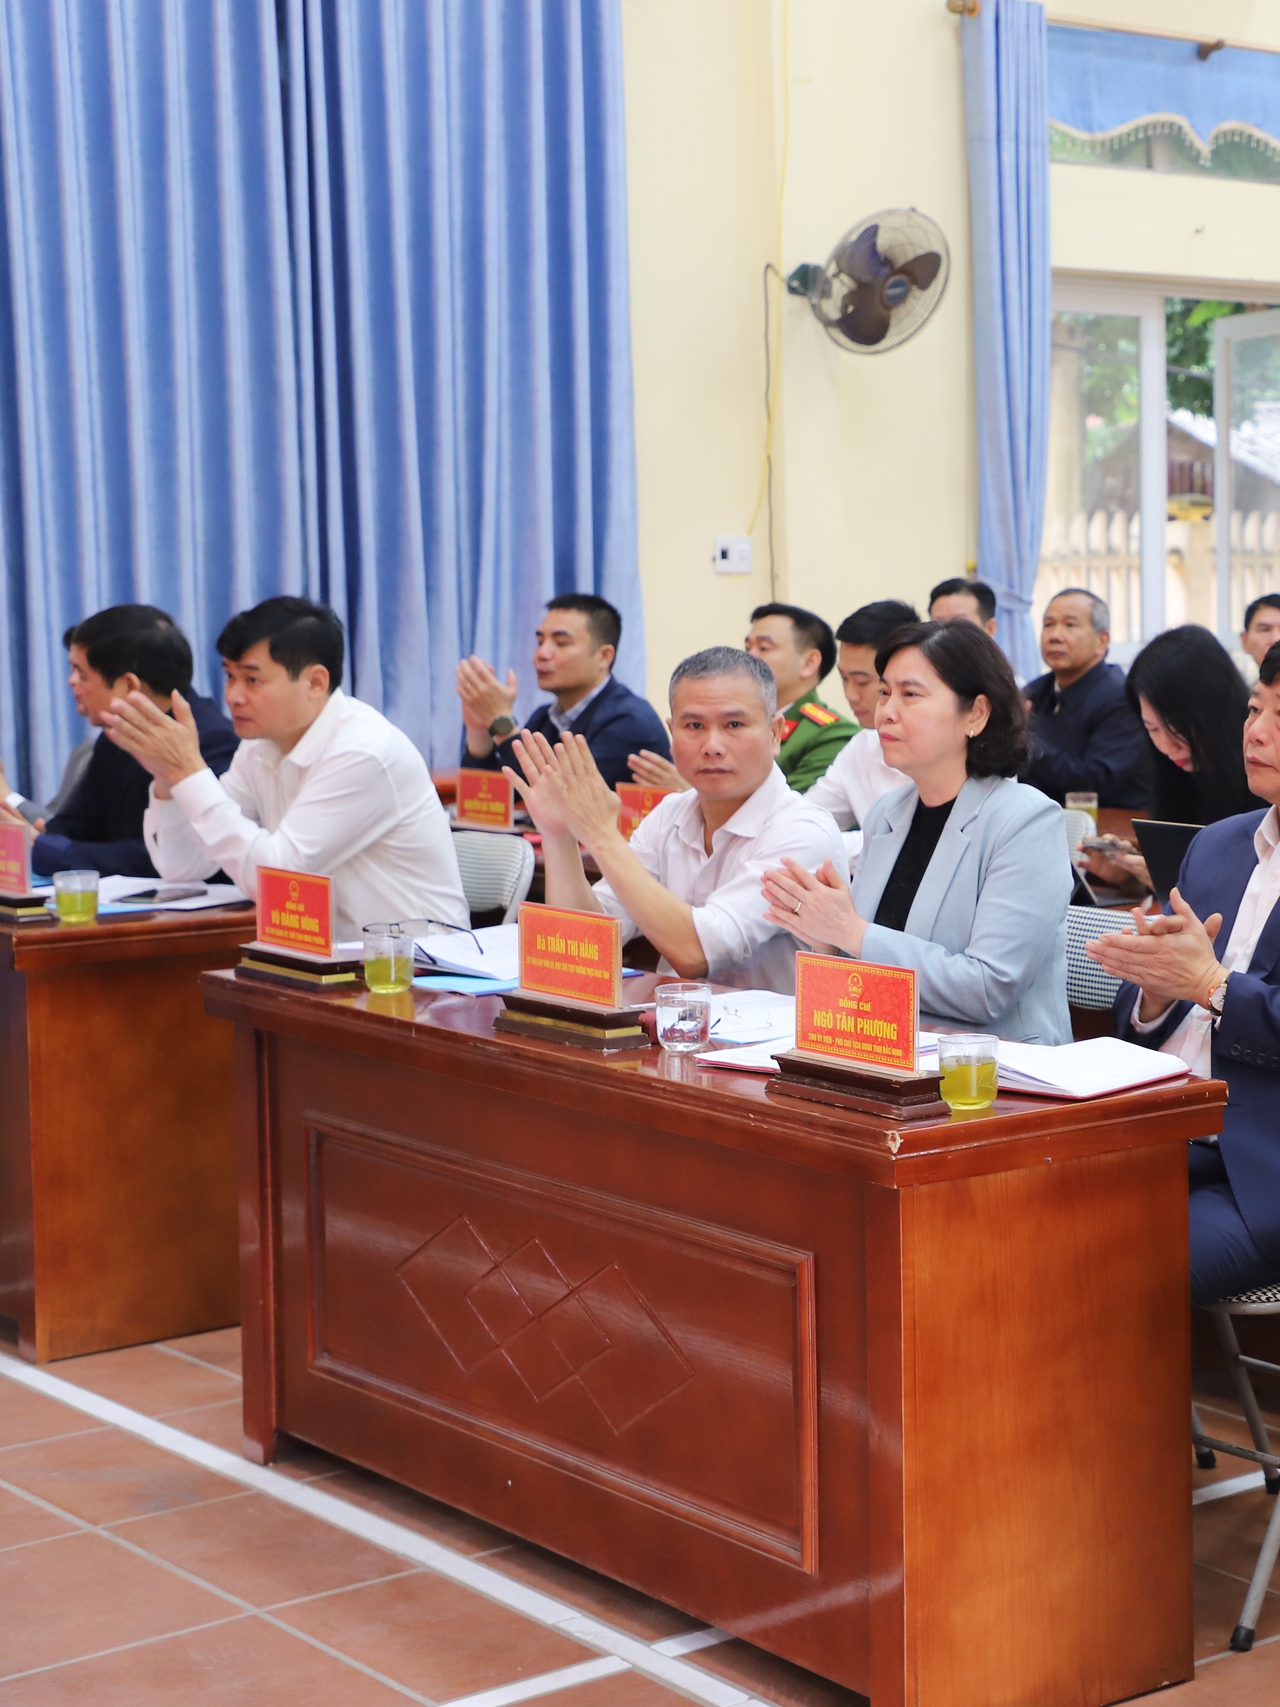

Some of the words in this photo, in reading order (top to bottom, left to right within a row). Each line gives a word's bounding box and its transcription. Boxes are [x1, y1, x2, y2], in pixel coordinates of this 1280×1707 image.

[536, 933, 546, 951] Bà
[546, 931, 566, 954] TRẦN
[566, 938, 578, 960] THỊ
[579, 936, 599, 961] HẰNG
[839, 997, 858, 1010] ĐỒNG
[859, 1000, 871, 1012] CHÍ
[813, 1009, 834, 1029] NGÔ
[835, 1011, 855, 1033] TÂN
[857, 1017, 898, 1042] PHƯỢNG
